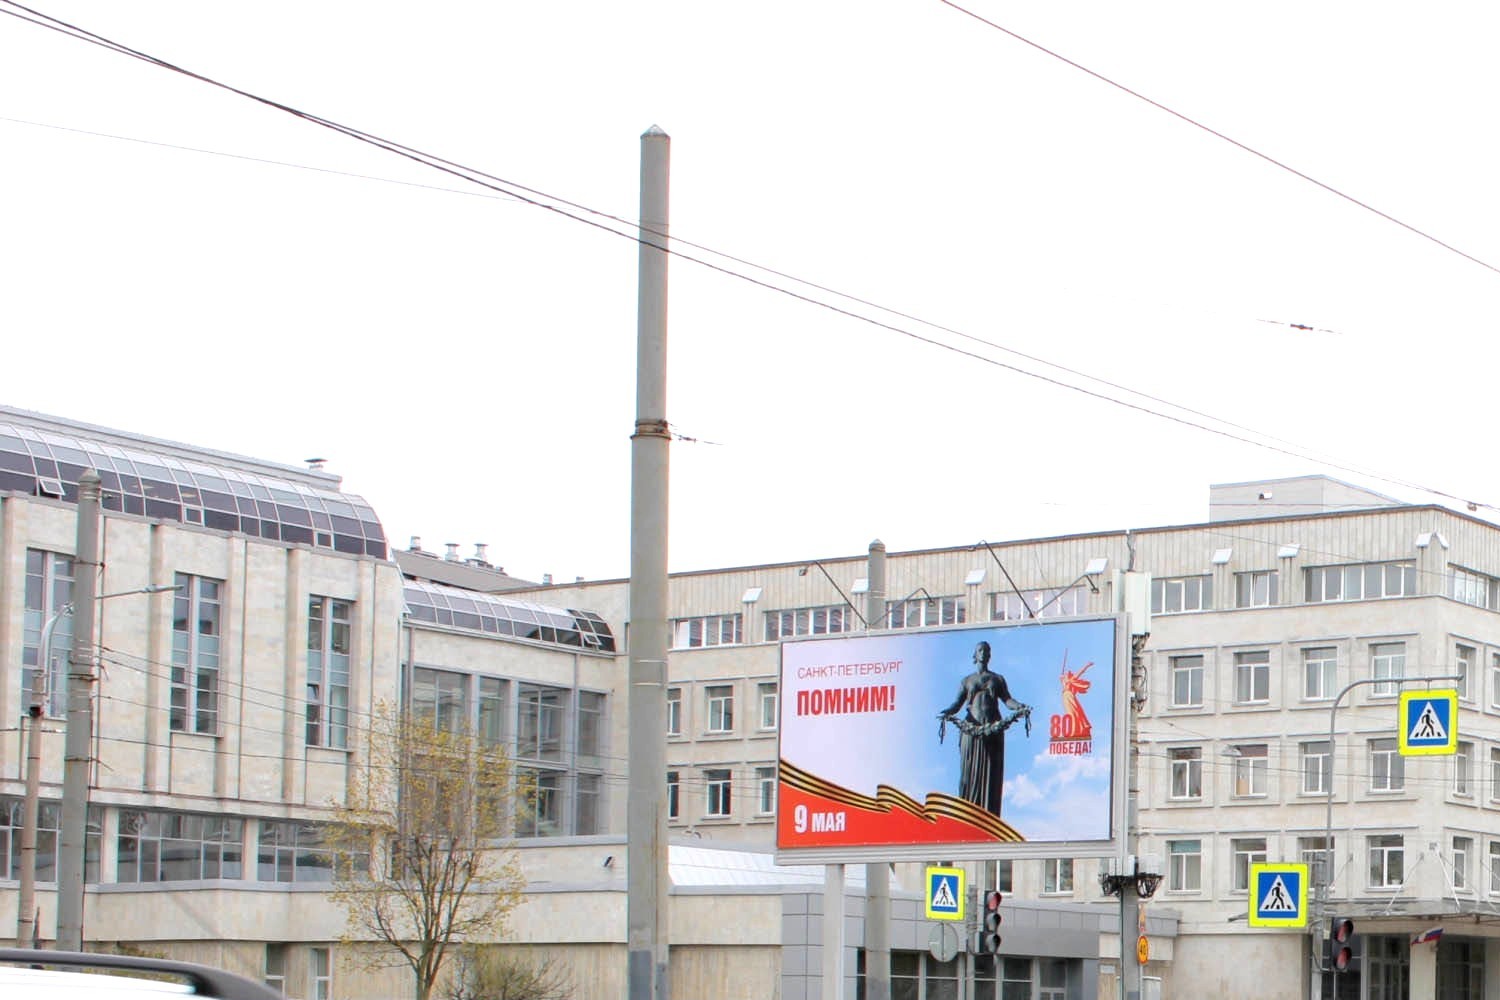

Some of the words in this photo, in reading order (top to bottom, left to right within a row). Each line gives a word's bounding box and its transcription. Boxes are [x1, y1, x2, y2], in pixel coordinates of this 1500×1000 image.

[797, 661, 903, 679] САНКТ-ПЕТЕРБУРГ
[797, 685, 896, 716] ПОМНИМ!
[1050, 713, 1073, 738] 80
[1049, 741, 1092, 756] ПОБЕДА!
[794, 804, 808, 833] 9
[812, 811, 846, 833] МАЯ
